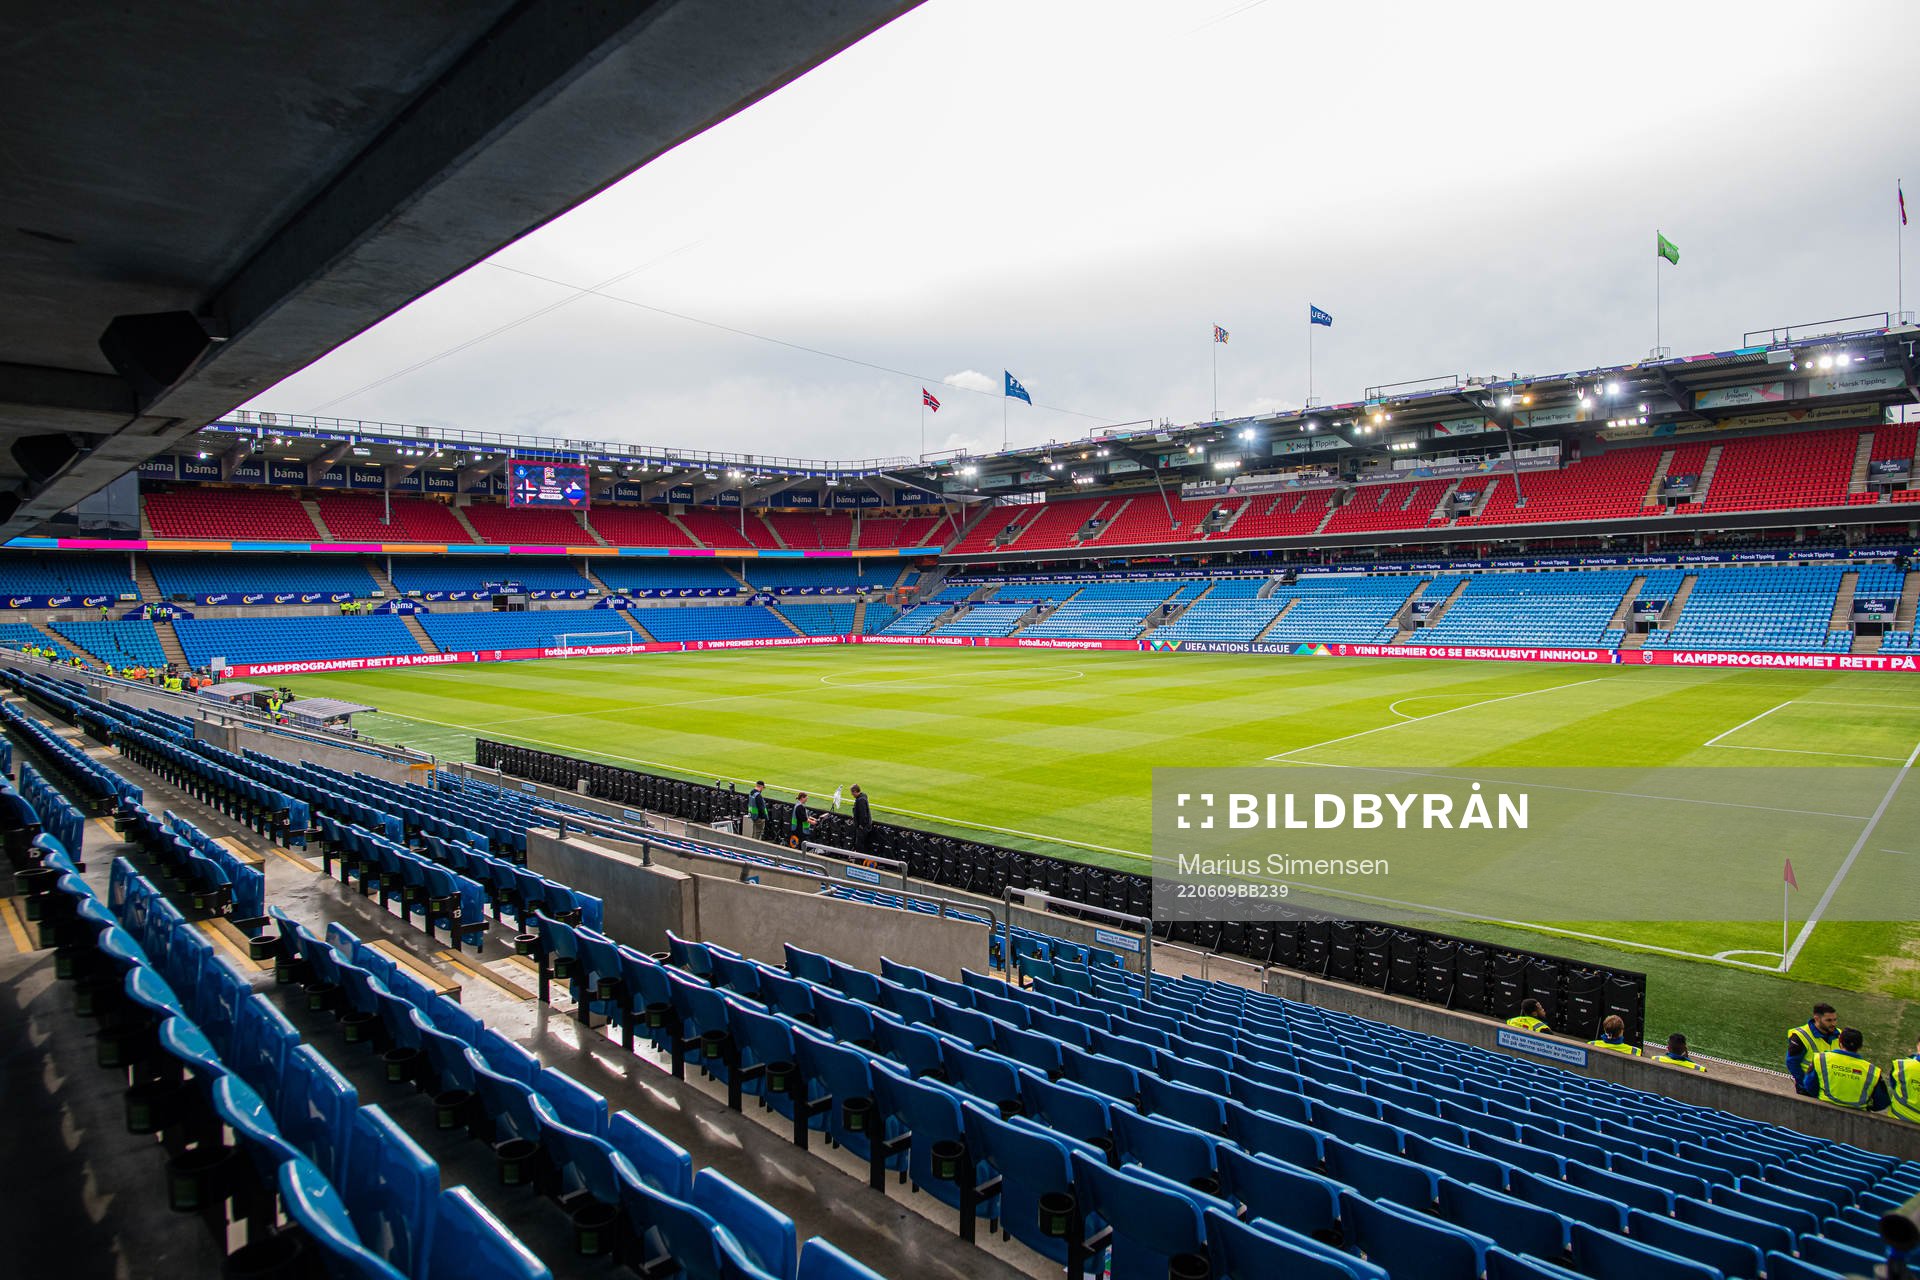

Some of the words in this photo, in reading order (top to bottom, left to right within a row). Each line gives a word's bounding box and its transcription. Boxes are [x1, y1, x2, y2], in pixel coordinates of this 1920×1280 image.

[235, 467, 260, 476] ama
[1798, 552, 1814, 560] Norsk
[1816, 552, 1834, 560] Tipping
[1018, 638, 1102, 649] fotball.no/kampprogram
[1185, 642, 1207, 651] UEFA
[1209, 643, 1250, 652] NATIONS
[1252, 644, 1290, 653] LEAGUE
[545, 644, 646, 656] fotball.no/kampprogram
[1354, 646, 1379, 655] VINN
[1381, 647, 1427, 656] PREMIER
[1429, 648, 1445, 657] OG
[1447, 648, 1463, 657] SE
[1464, 649, 1537, 659] EKSKLUSIVT
[1540, 650, 1598, 661] INNHOLD
[250, 659, 365, 675] KAMPPROGRAMMET
[367, 656, 395, 667] RETT
[396, 655, 412, 665] PÅ
[413, 653, 458, 664] MOBILEN
[1673, 653, 1835, 667] KAMPPROGRAMMET
[1840, 656, 1886, 668] RETT
[1891, 656, 1916, 668] PÅ
